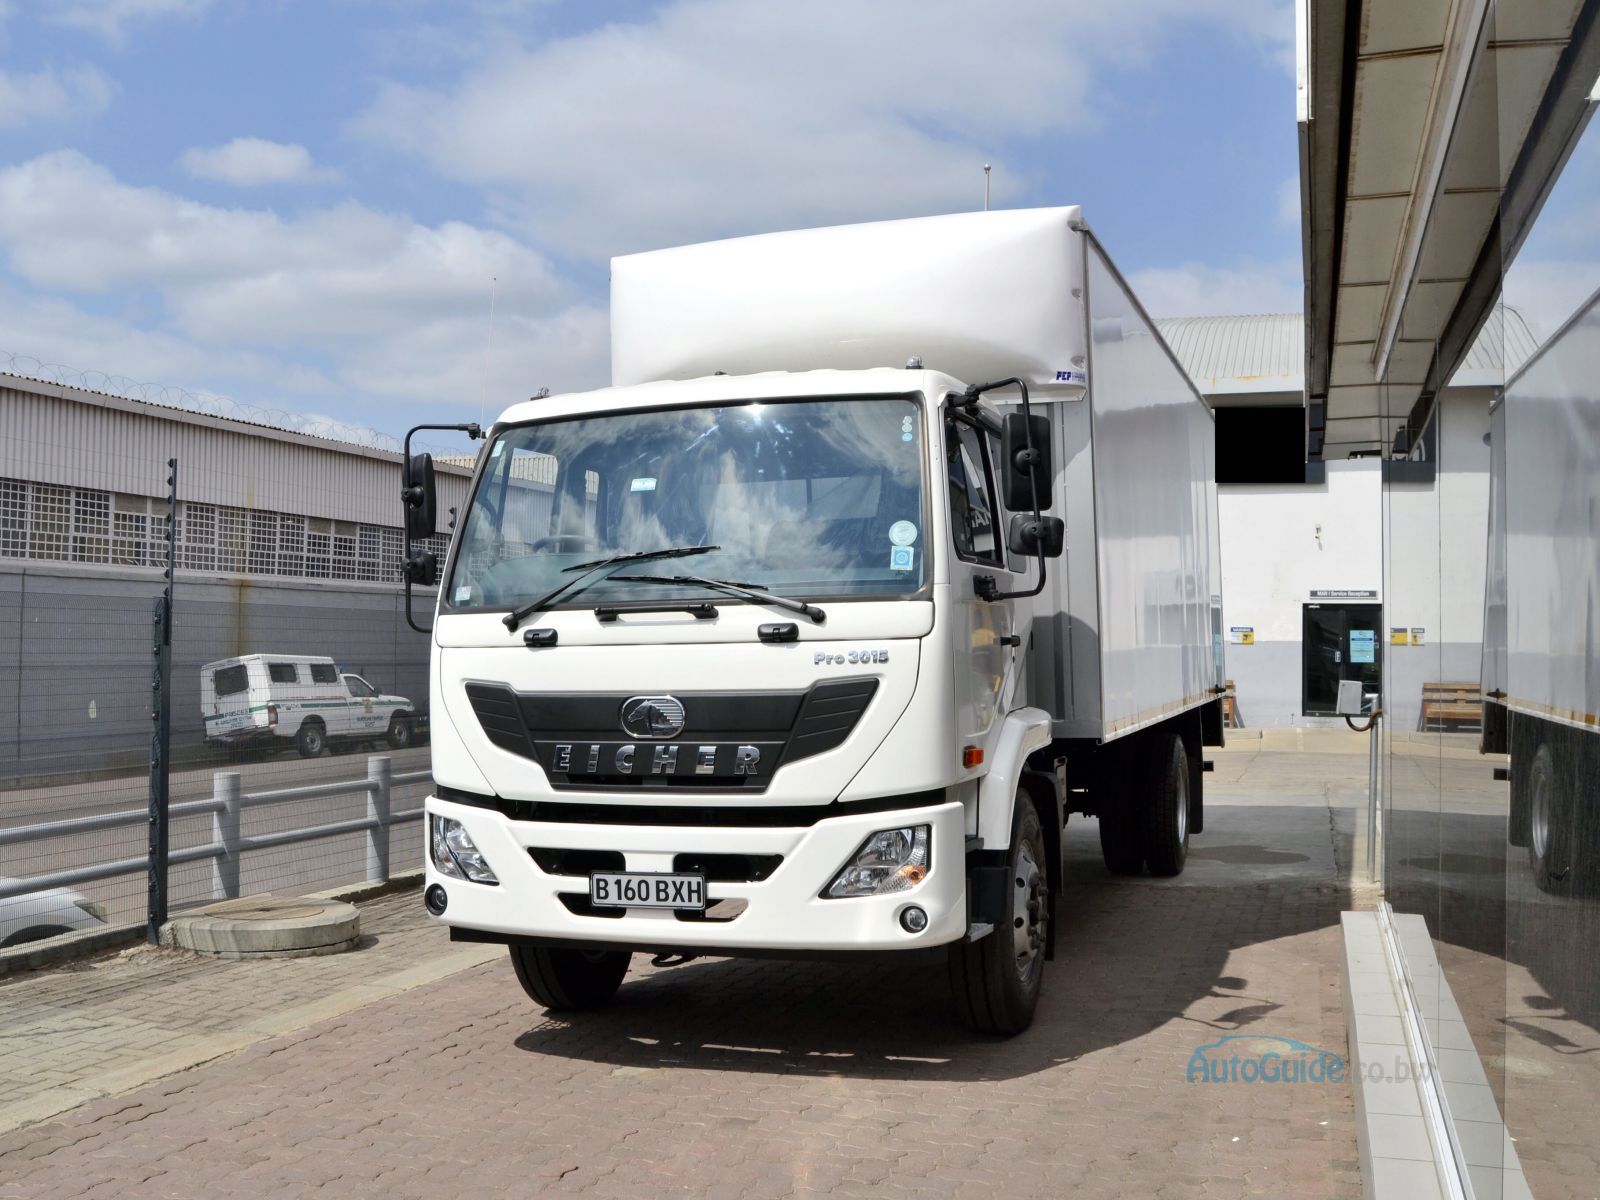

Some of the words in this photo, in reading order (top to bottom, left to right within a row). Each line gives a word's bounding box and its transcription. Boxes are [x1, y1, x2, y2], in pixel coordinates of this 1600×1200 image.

[814, 650, 845, 665] Pro
[848, 649, 890, 665] 3015
[552, 744, 761, 775] EICHER
[595, 878, 610, 901] B
[614, 878, 651, 903] 160
[655, 880, 703, 903] BXH
